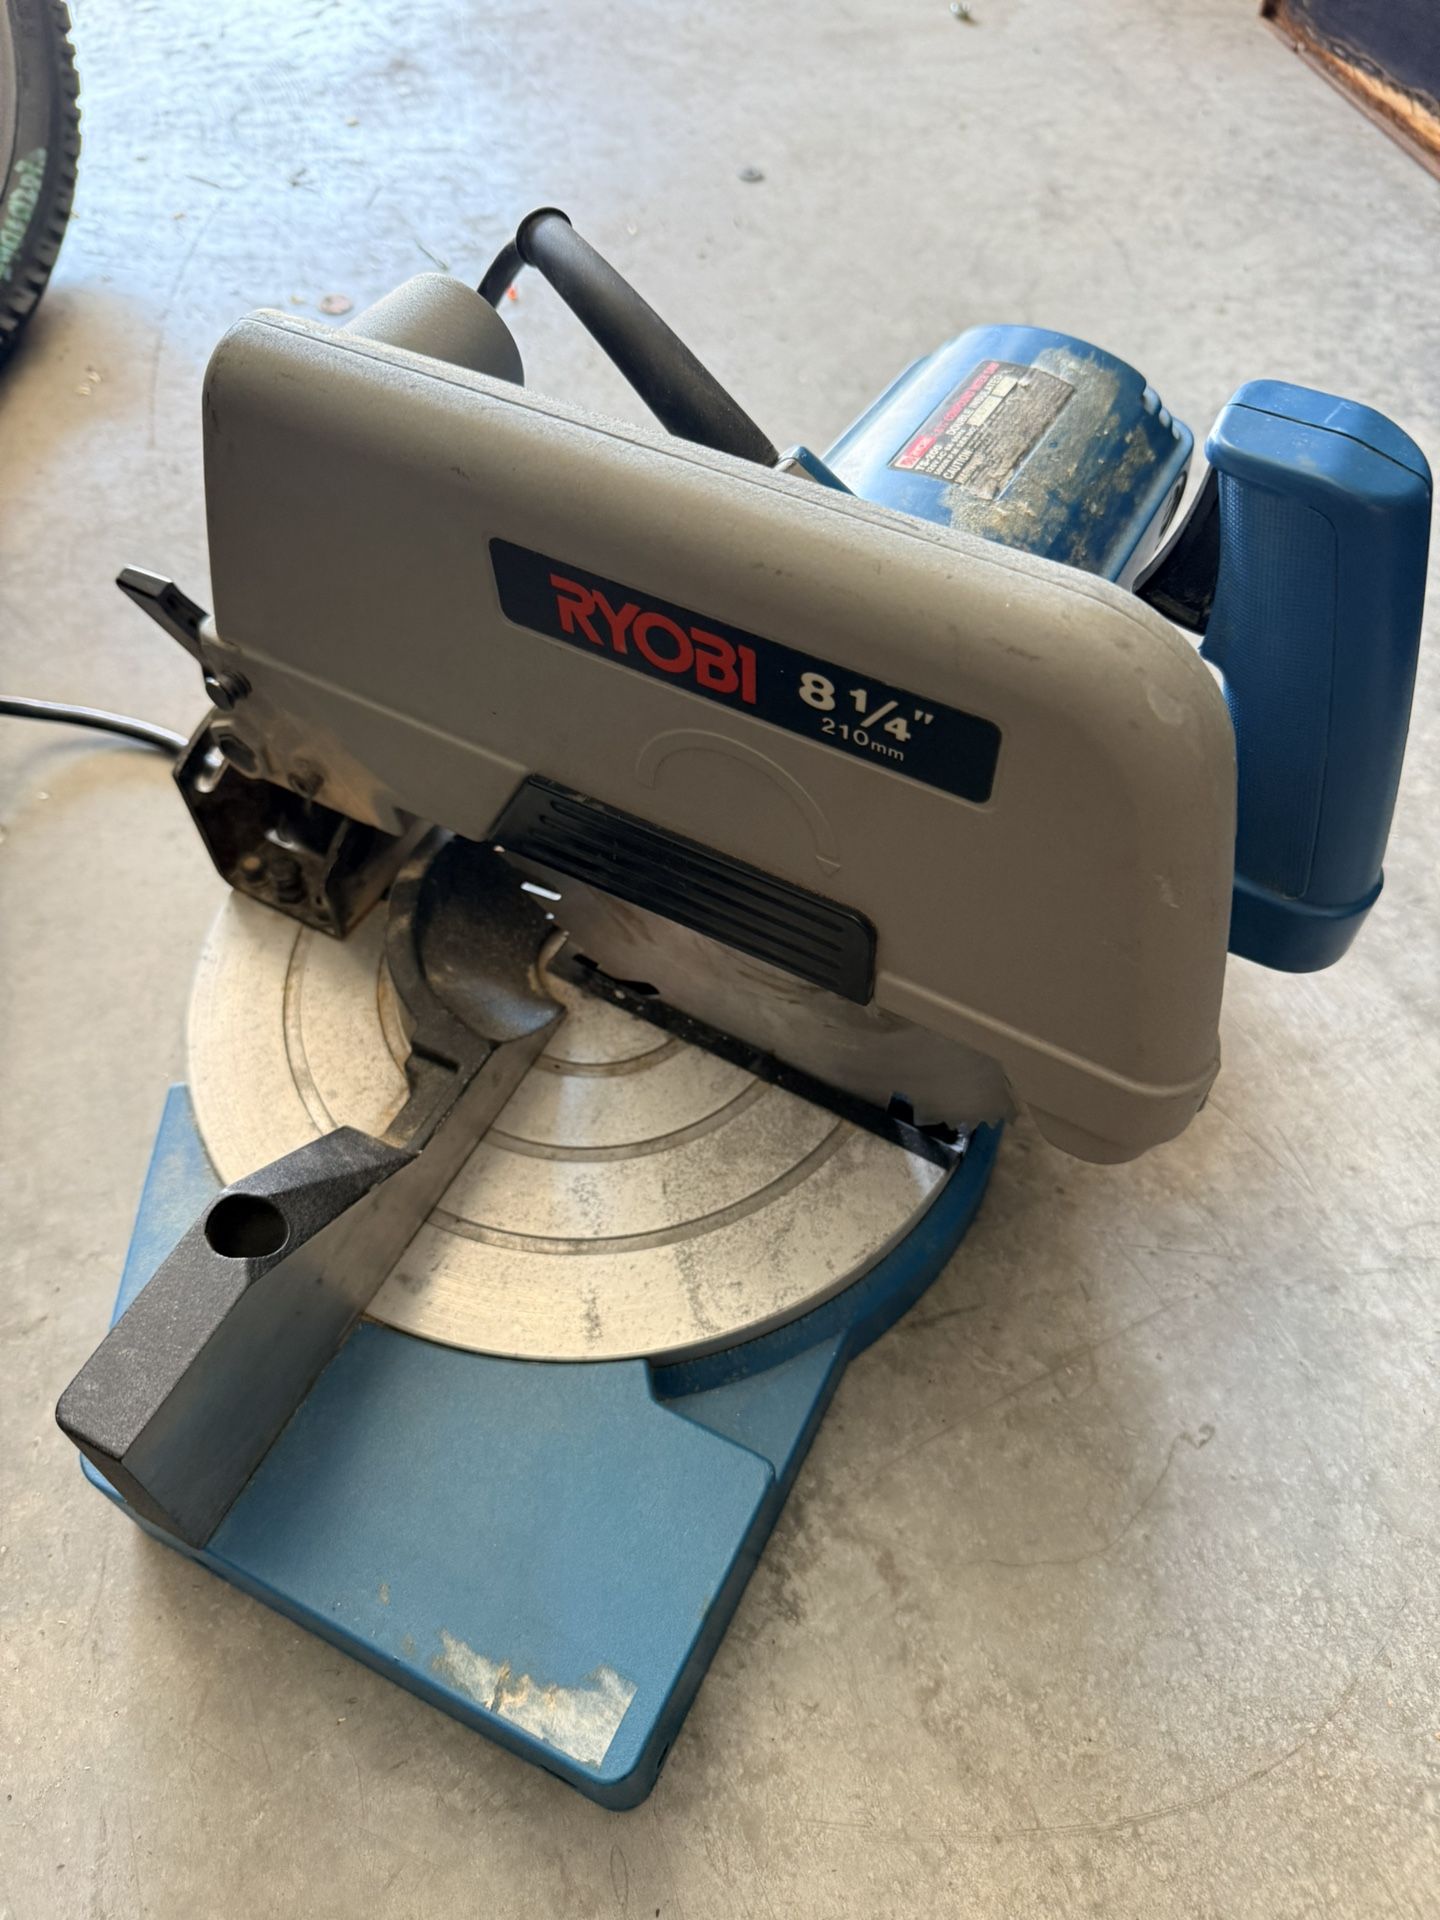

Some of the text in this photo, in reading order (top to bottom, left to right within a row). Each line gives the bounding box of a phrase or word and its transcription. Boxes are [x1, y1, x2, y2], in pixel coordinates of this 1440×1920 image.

[945, 407, 974, 435] DOUBLE
[550, 573, 756, 704] RYOBI
[799, 672, 934, 742] 8 1/4"
[822, 717, 904, 762] 210mm
